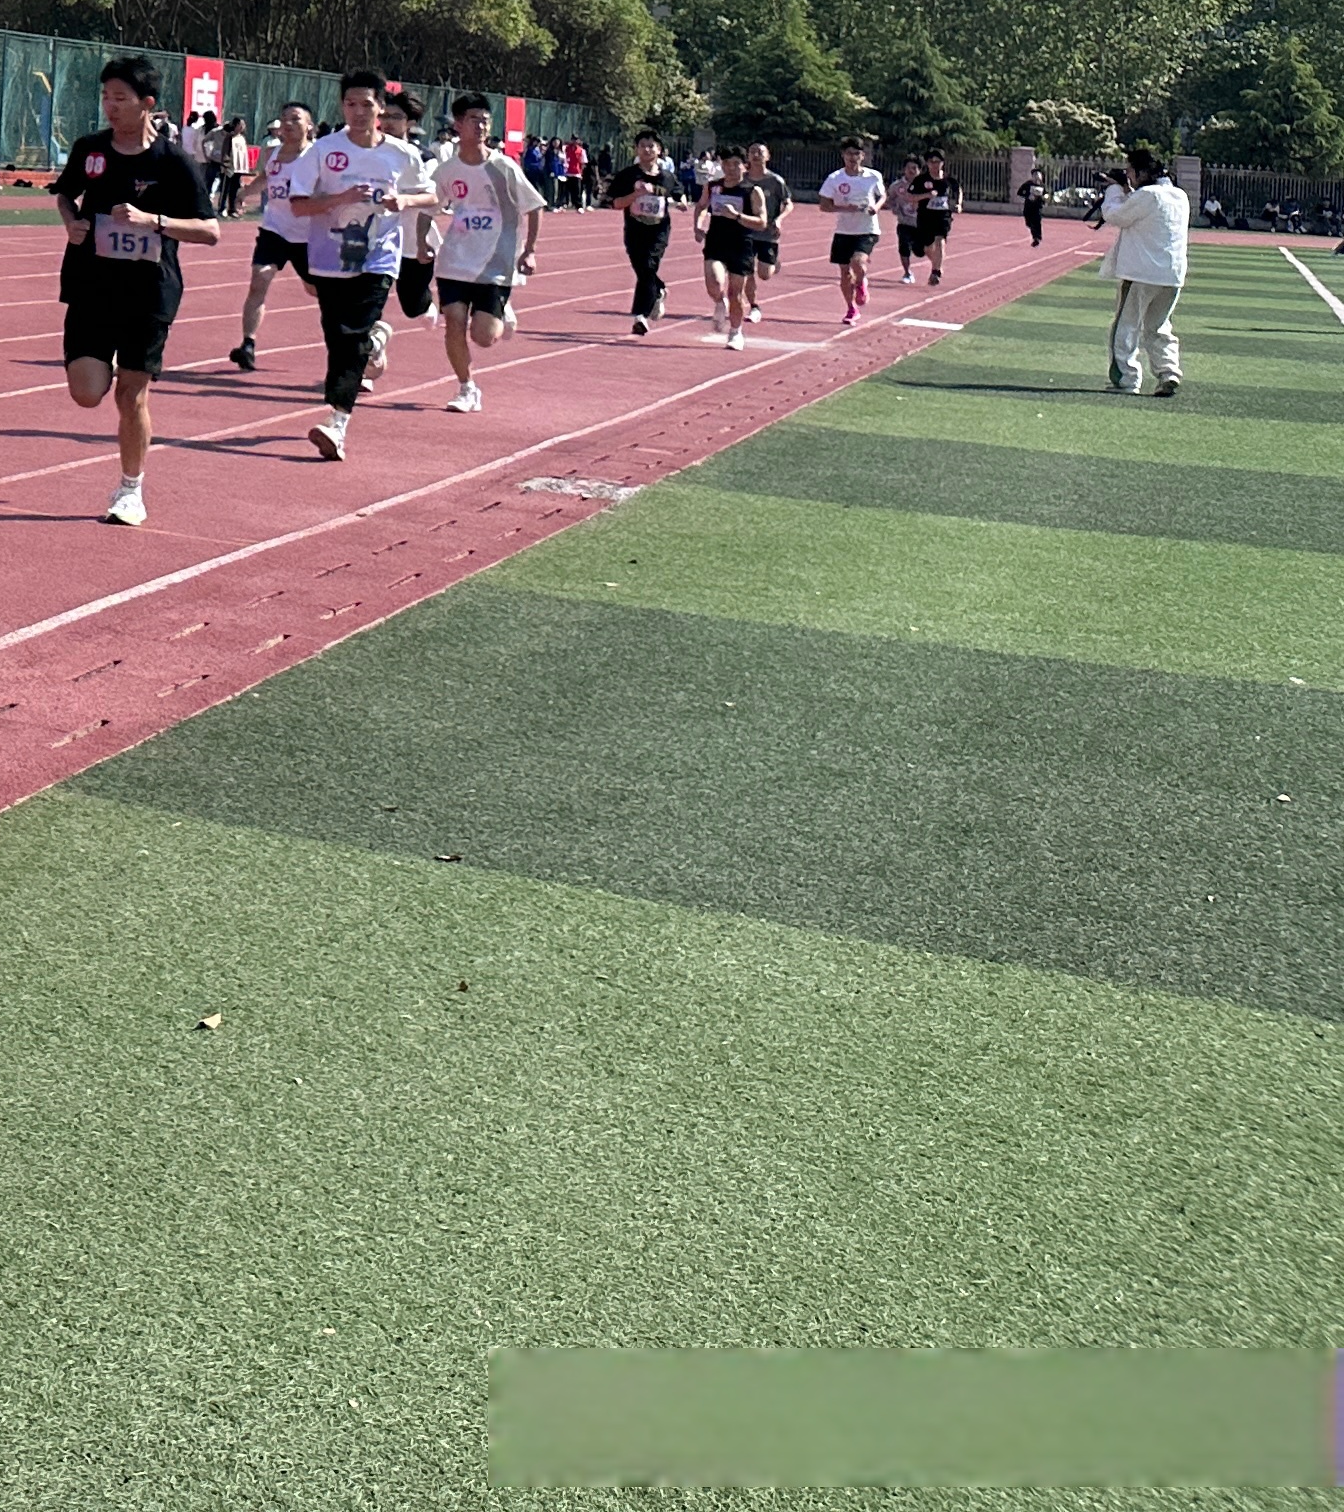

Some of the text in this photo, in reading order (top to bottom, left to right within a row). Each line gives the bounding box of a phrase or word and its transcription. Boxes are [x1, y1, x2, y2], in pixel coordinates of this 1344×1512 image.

[85, 154, 106, 175] 08
[326, 153, 348, 170] 02
[463, 215, 493, 230] 192
[108, 232, 149, 254] 151
